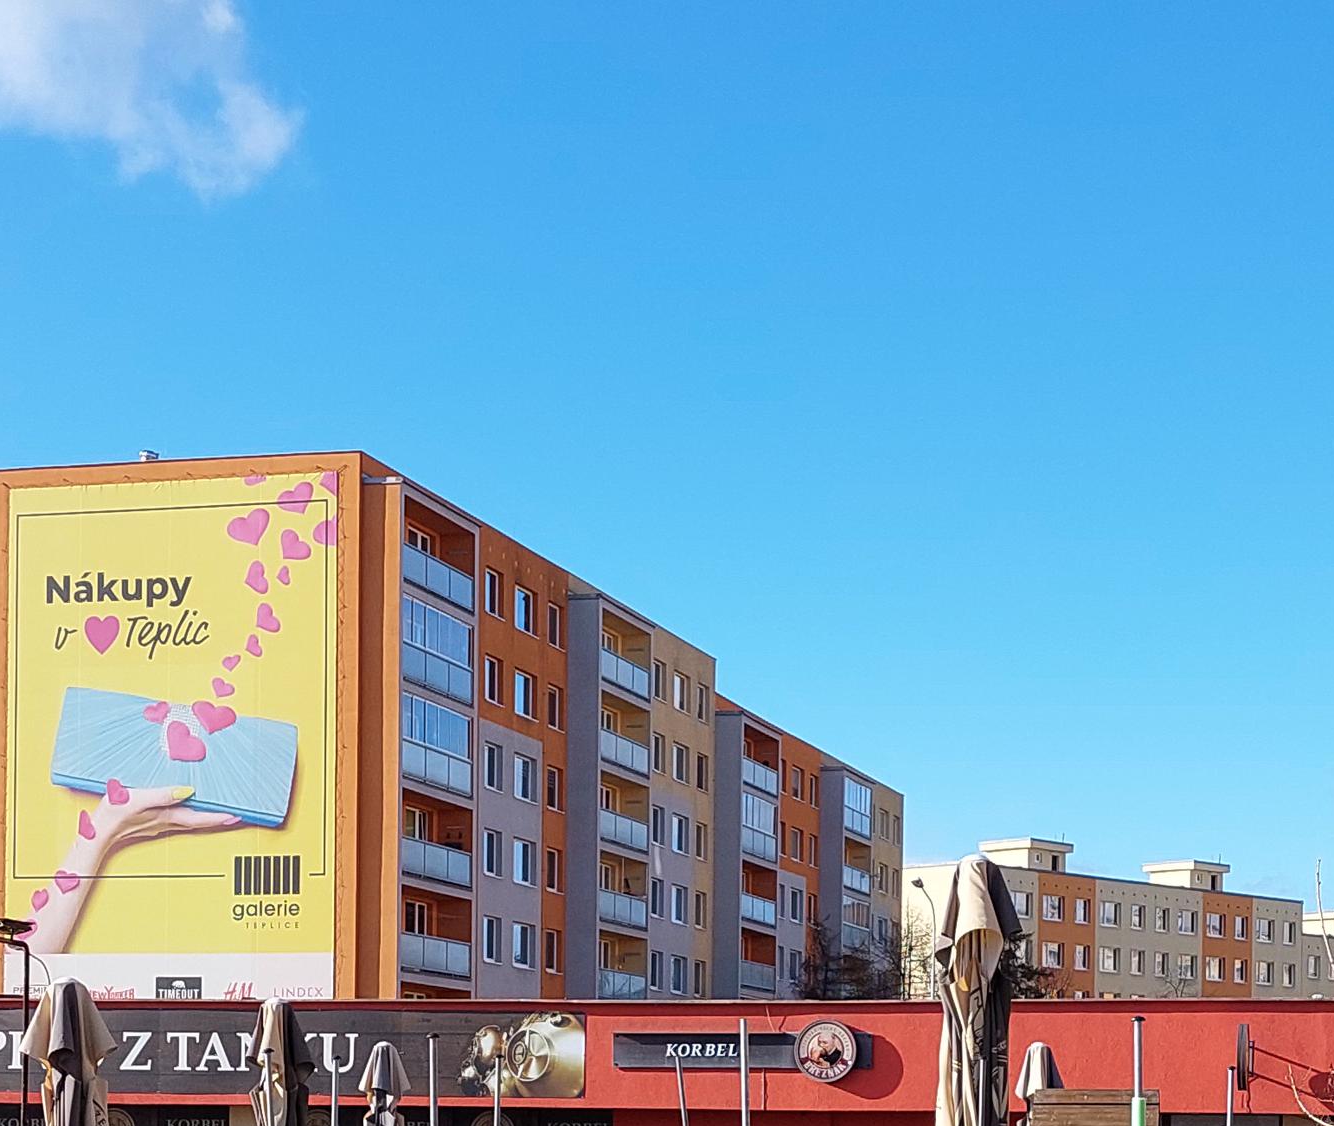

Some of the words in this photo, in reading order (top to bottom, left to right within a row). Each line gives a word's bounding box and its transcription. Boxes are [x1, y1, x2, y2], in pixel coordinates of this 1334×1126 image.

[46, 572, 192, 608] Nákupy
[54, 626, 78, 650] v
[125, 610, 210, 660] Teplic
[232, 900, 300, 921] galerie
[158, 988, 200, 1000] TIMEOUT
[273, 986, 324, 998] LINDEX
[119, 1031, 153, 1071] Z
[666, 1043, 739, 1058] KORBEL
